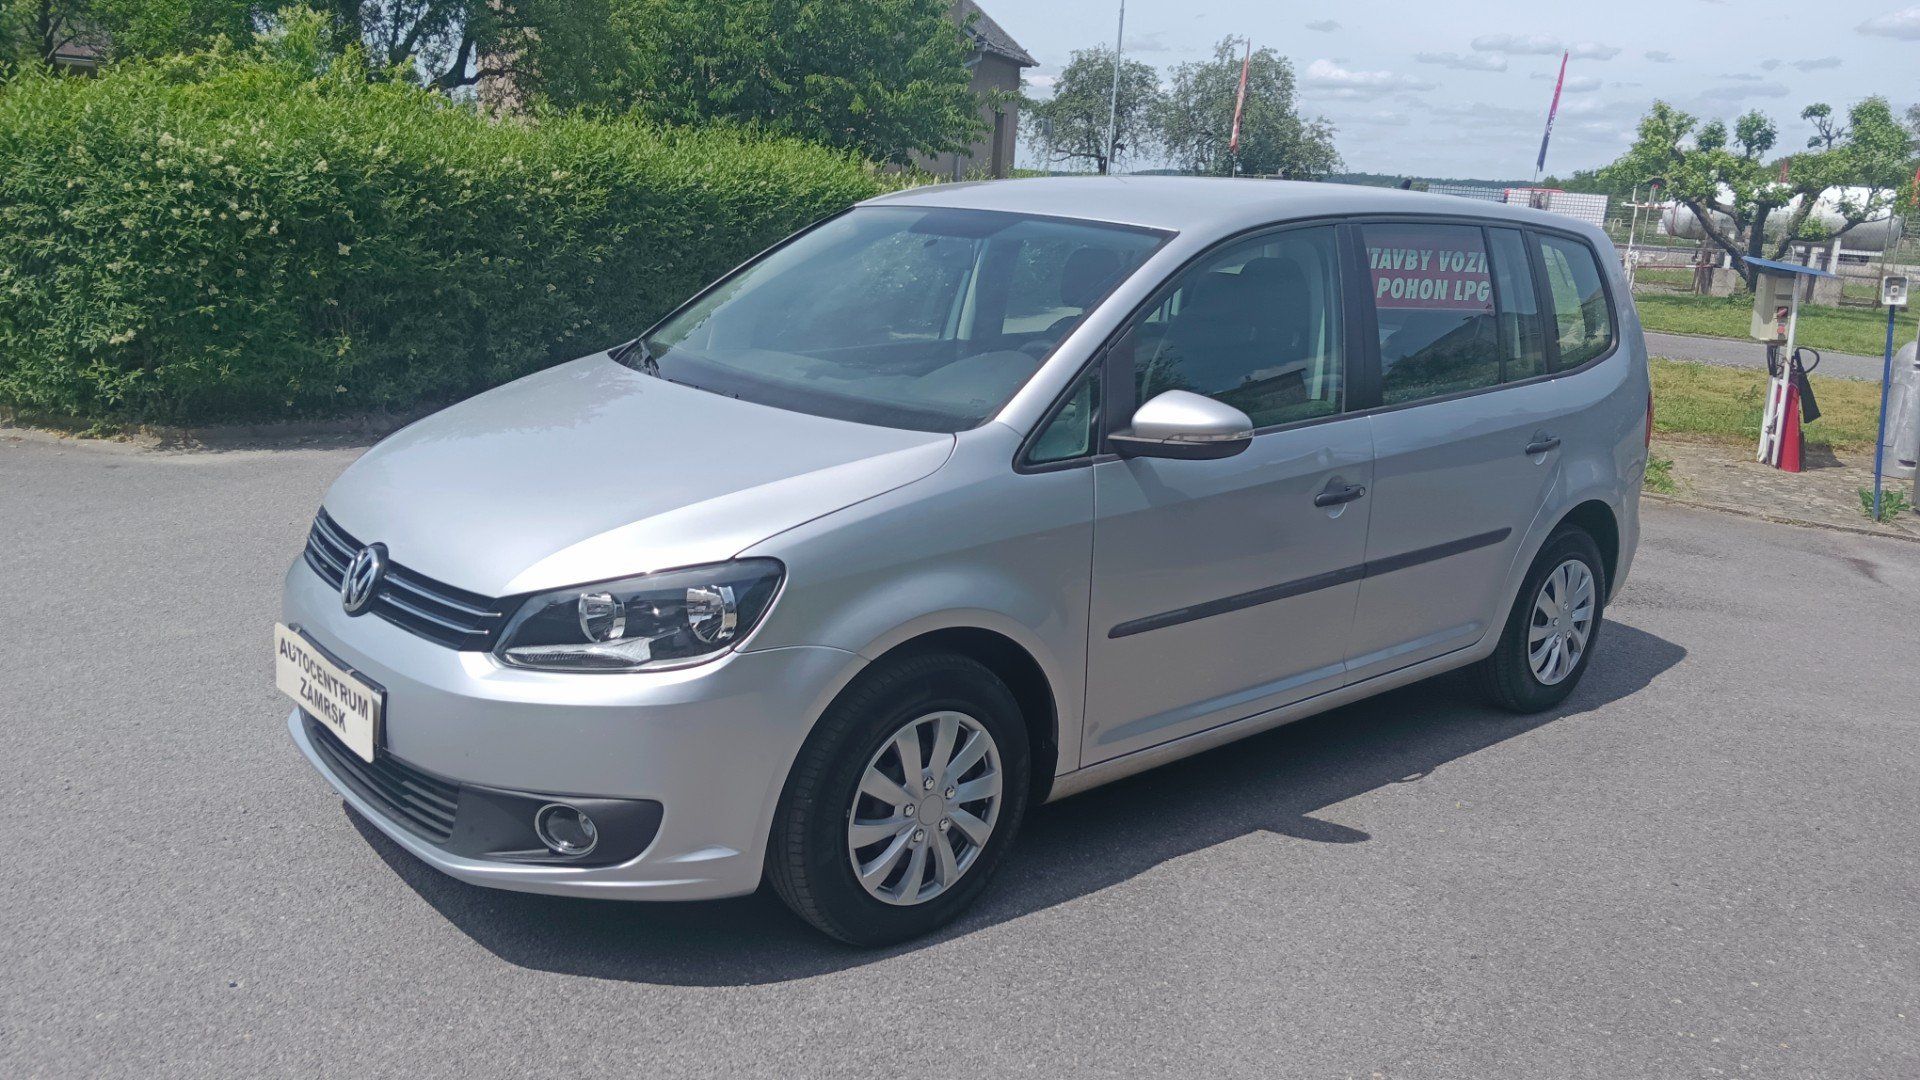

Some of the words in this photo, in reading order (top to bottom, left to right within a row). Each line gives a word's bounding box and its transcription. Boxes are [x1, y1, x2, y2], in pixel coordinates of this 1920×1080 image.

[1366, 247, 1432, 271] TAVBY
[1376, 277, 1448, 300] POHON
[1453, 280, 1490, 302] LPG
[279, 637, 369, 721] AUTOCENTRUM
[300, 676, 347, 734] ZÁMRSK
